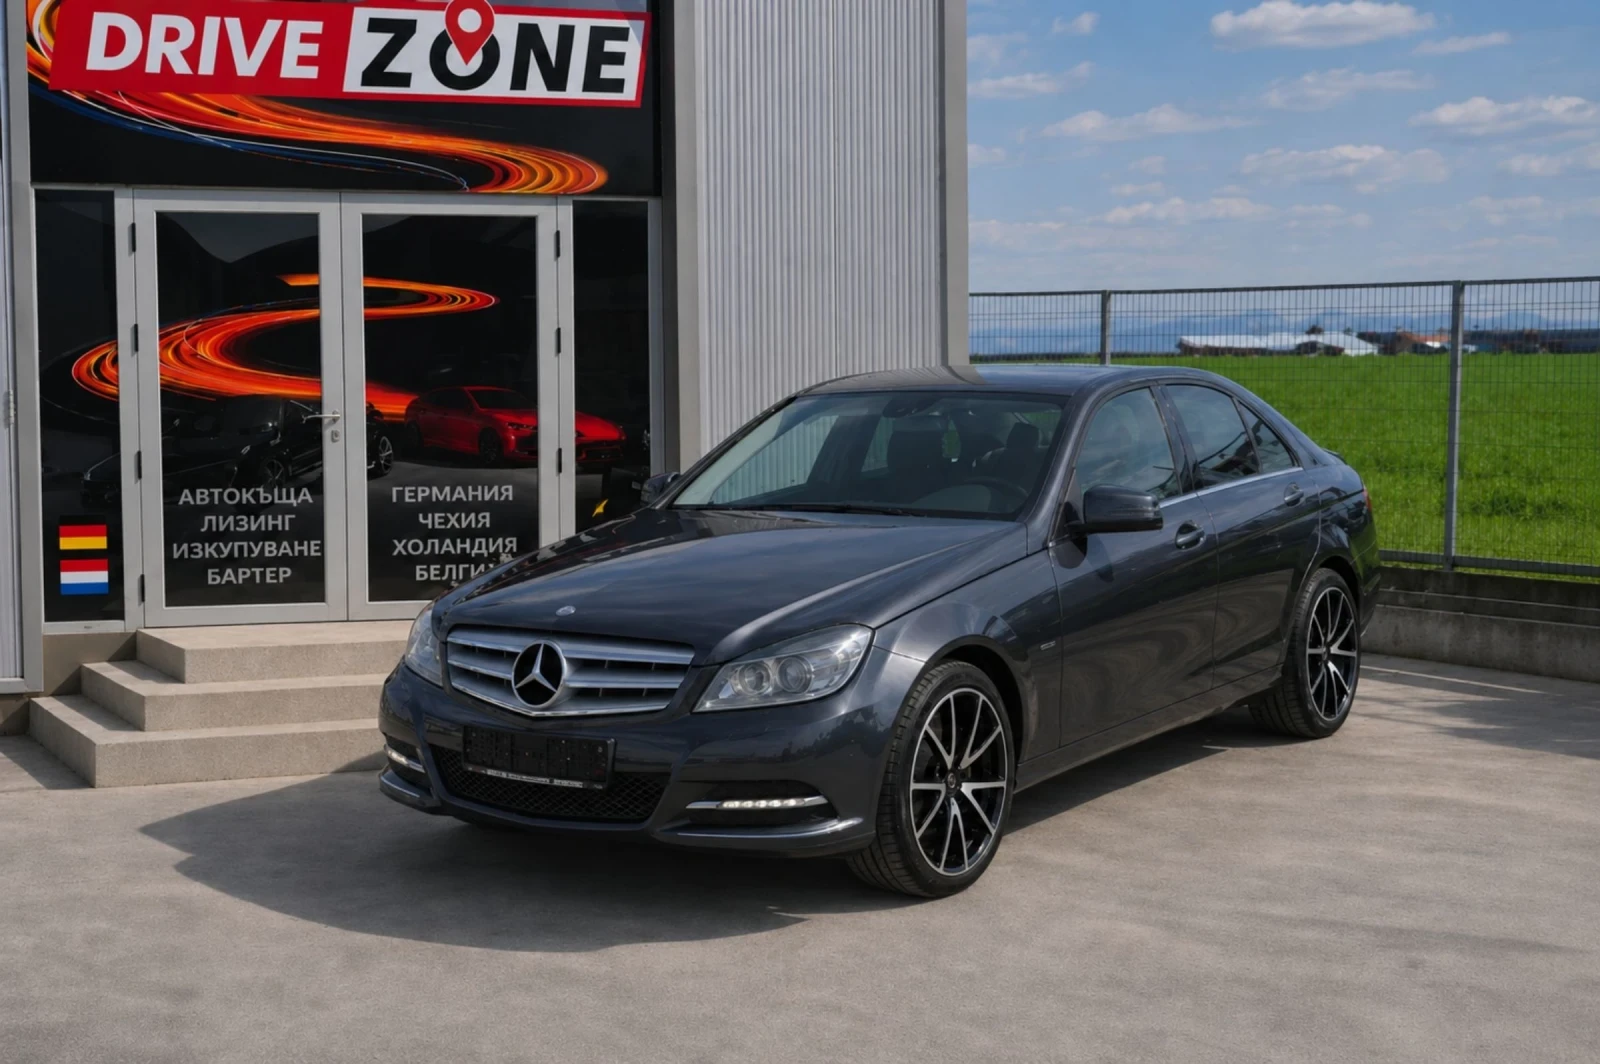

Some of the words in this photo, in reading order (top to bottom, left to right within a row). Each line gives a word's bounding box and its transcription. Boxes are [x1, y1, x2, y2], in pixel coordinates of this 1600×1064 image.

[85, 11, 325, 80] DRIVE
[360, 16, 631, 94] ZONE
[178, 487, 313, 507] АВТОКЪЩА
[391, 484, 514, 503] ГЕРМАНИЯ
[200, 514, 296, 532] ЛИЗИНГ
[418, 511, 491, 529] ЧЕХИЯ
[172, 540, 322, 559] ИЗКУПУВАНЕ
[391, 537, 518, 557] ХОЛАНДИЯ
[207, 567, 292, 585] БАРТЕР
[415, 563, 495, 582] БЕЛГИ
